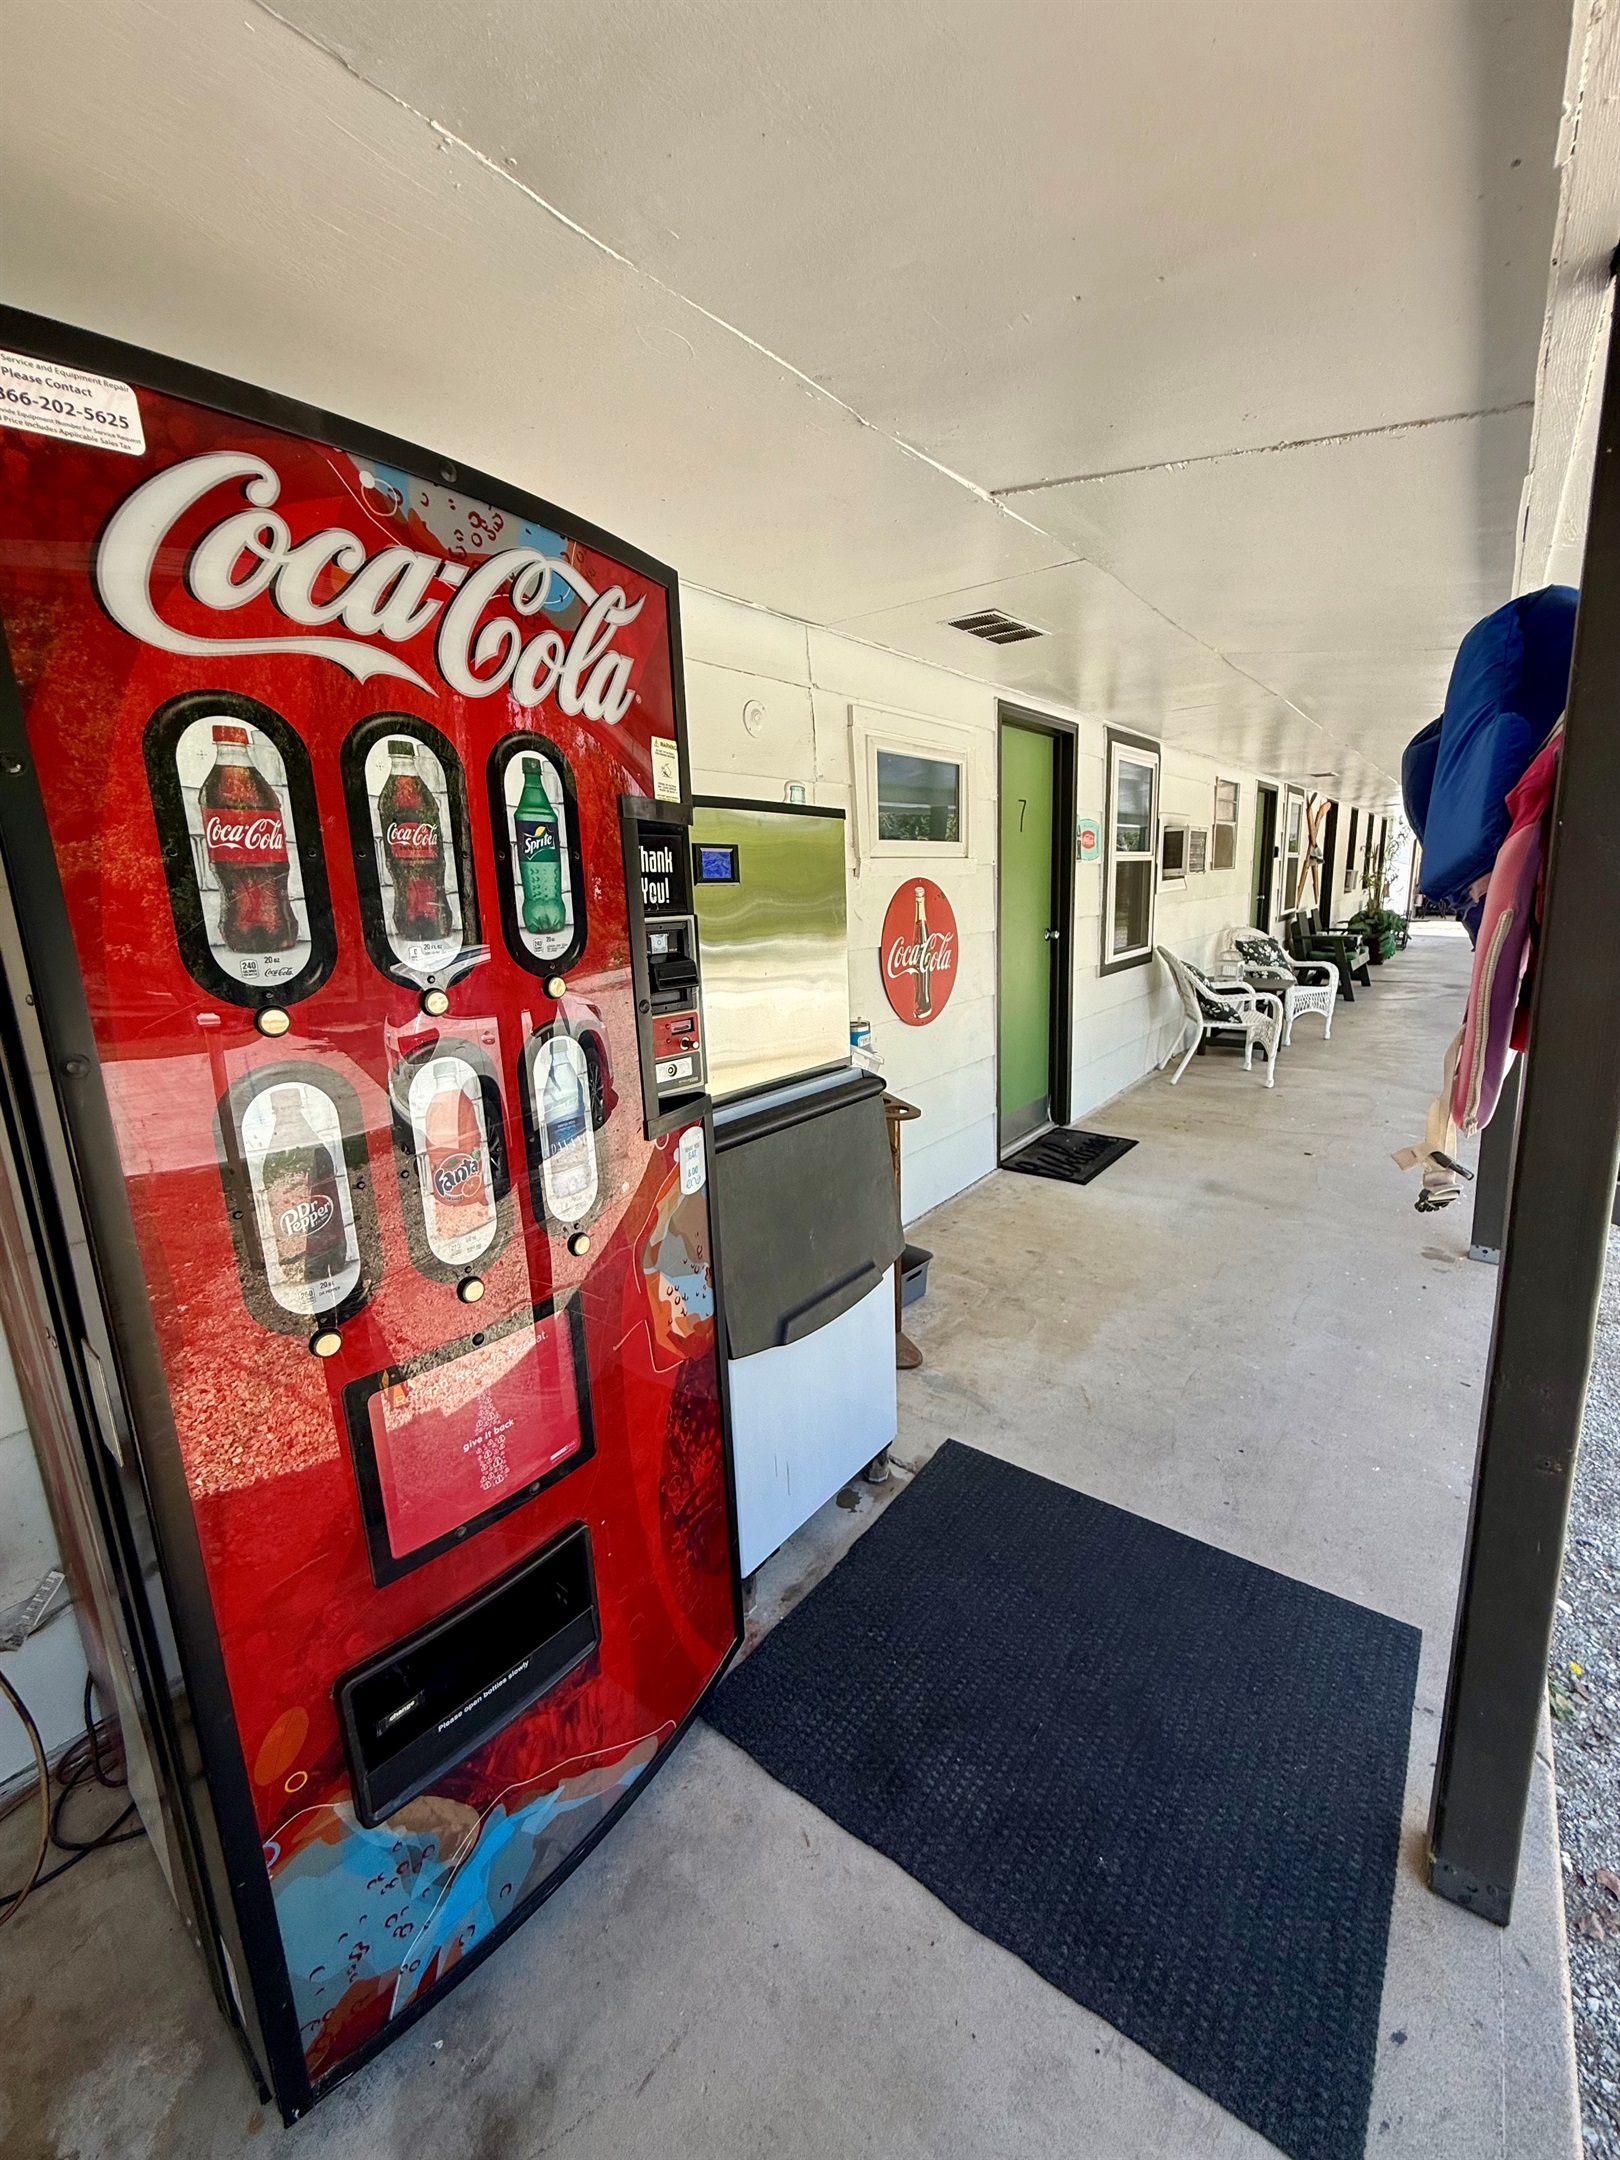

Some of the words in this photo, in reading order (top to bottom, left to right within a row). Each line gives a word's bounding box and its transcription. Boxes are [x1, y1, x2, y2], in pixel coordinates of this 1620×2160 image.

[1, 353, 34, 368] Service
[36, 364, 53, 373] and
[55, 367, 102, 386] Equipment
[1, 366, 42, 385] Please
[45, 378, 93, 398] Contact
[96, 451, 647, 725] Coca-Cola
[1018, 799, 1027, 833] 7
[206, 815, 283, 851] Coca-Cola
[387, 822, 438, 846] Coca-Cola
[524, 833, 553, 854] Sprite
[639, 846, 673, 873] hank
[641, 877, 670, 904] You!
[242, 961, 257, 970] 240
[264, 956, 273, 964] 20
[887, 931, 954, 979] Coca-Cola
[280, 1202, 331, 1236] Pepper
[296, 1200, 318, 1221] Dr
[463, 1437, 483, 1453] give
[484, 1431, 492, 1440] it
[493, 1418, 514, 1435] back
[389, 1700, 415, 1722] change
[438, 1710, 463, 1733] Please
[464, 1697, 483, 1713] open
[483, 1678, 507, 1699] bottles
[508, 1659, 530, 1680] slowly
